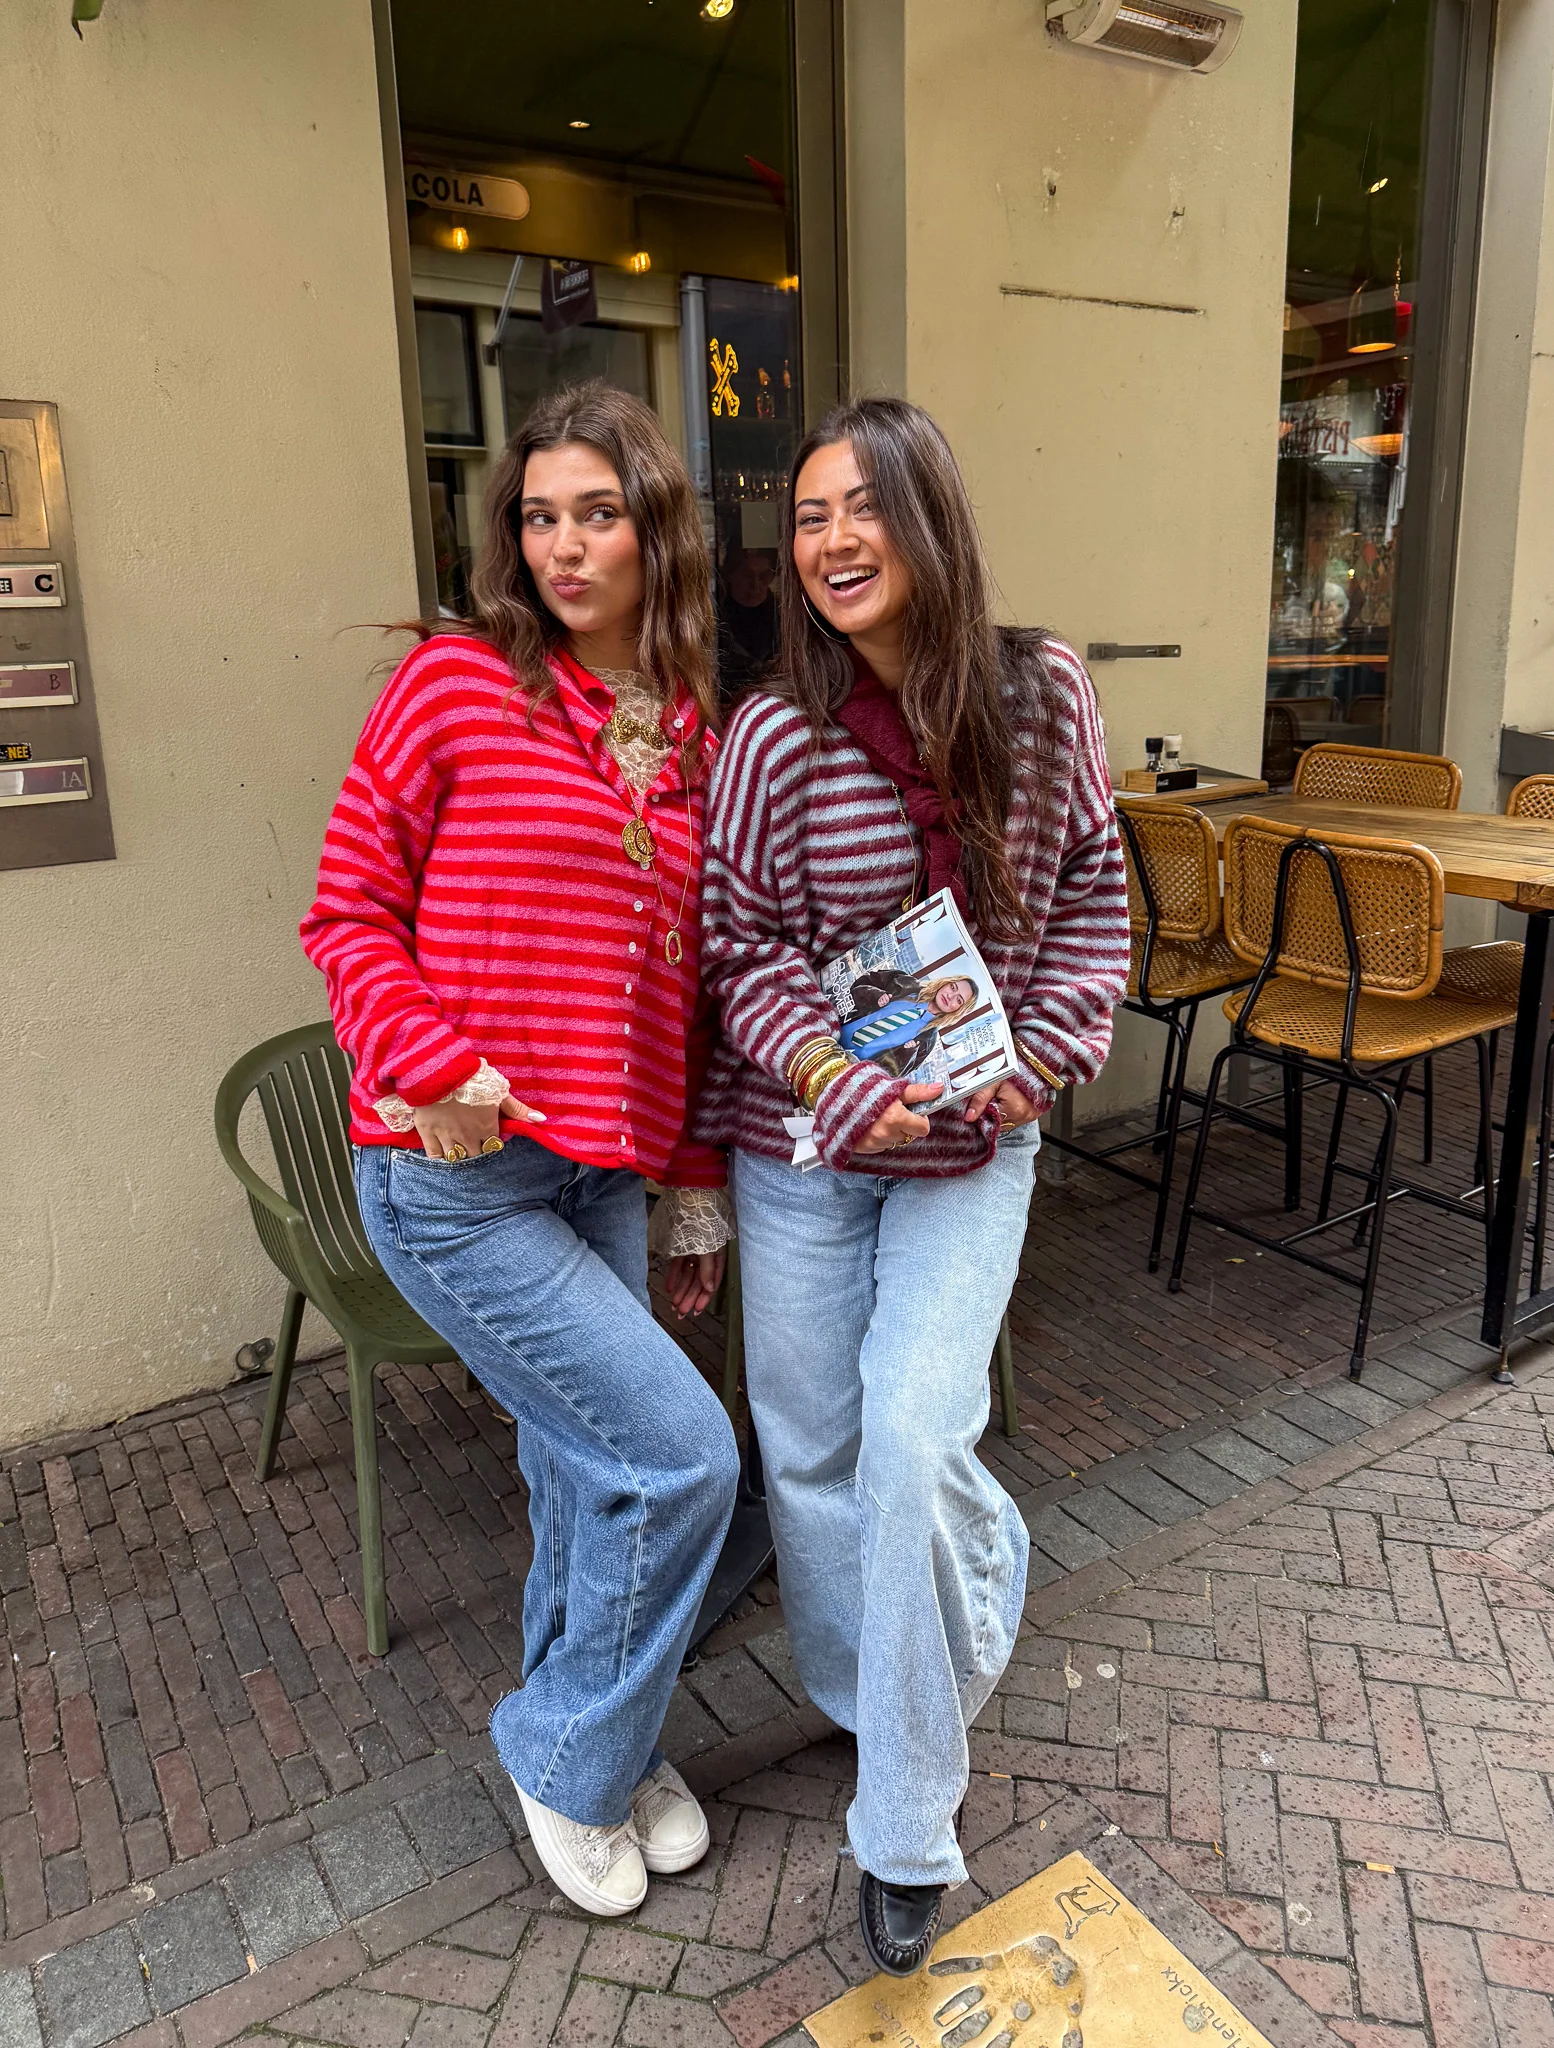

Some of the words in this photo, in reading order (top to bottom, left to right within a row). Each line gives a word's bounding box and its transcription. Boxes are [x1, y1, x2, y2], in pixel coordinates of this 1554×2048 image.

[411, 173, 485, 207] COLA
[34, 573, 54, 593] C
[50, 673, 61, 690] B
[894, 891, 1009, 1094] ELLE
